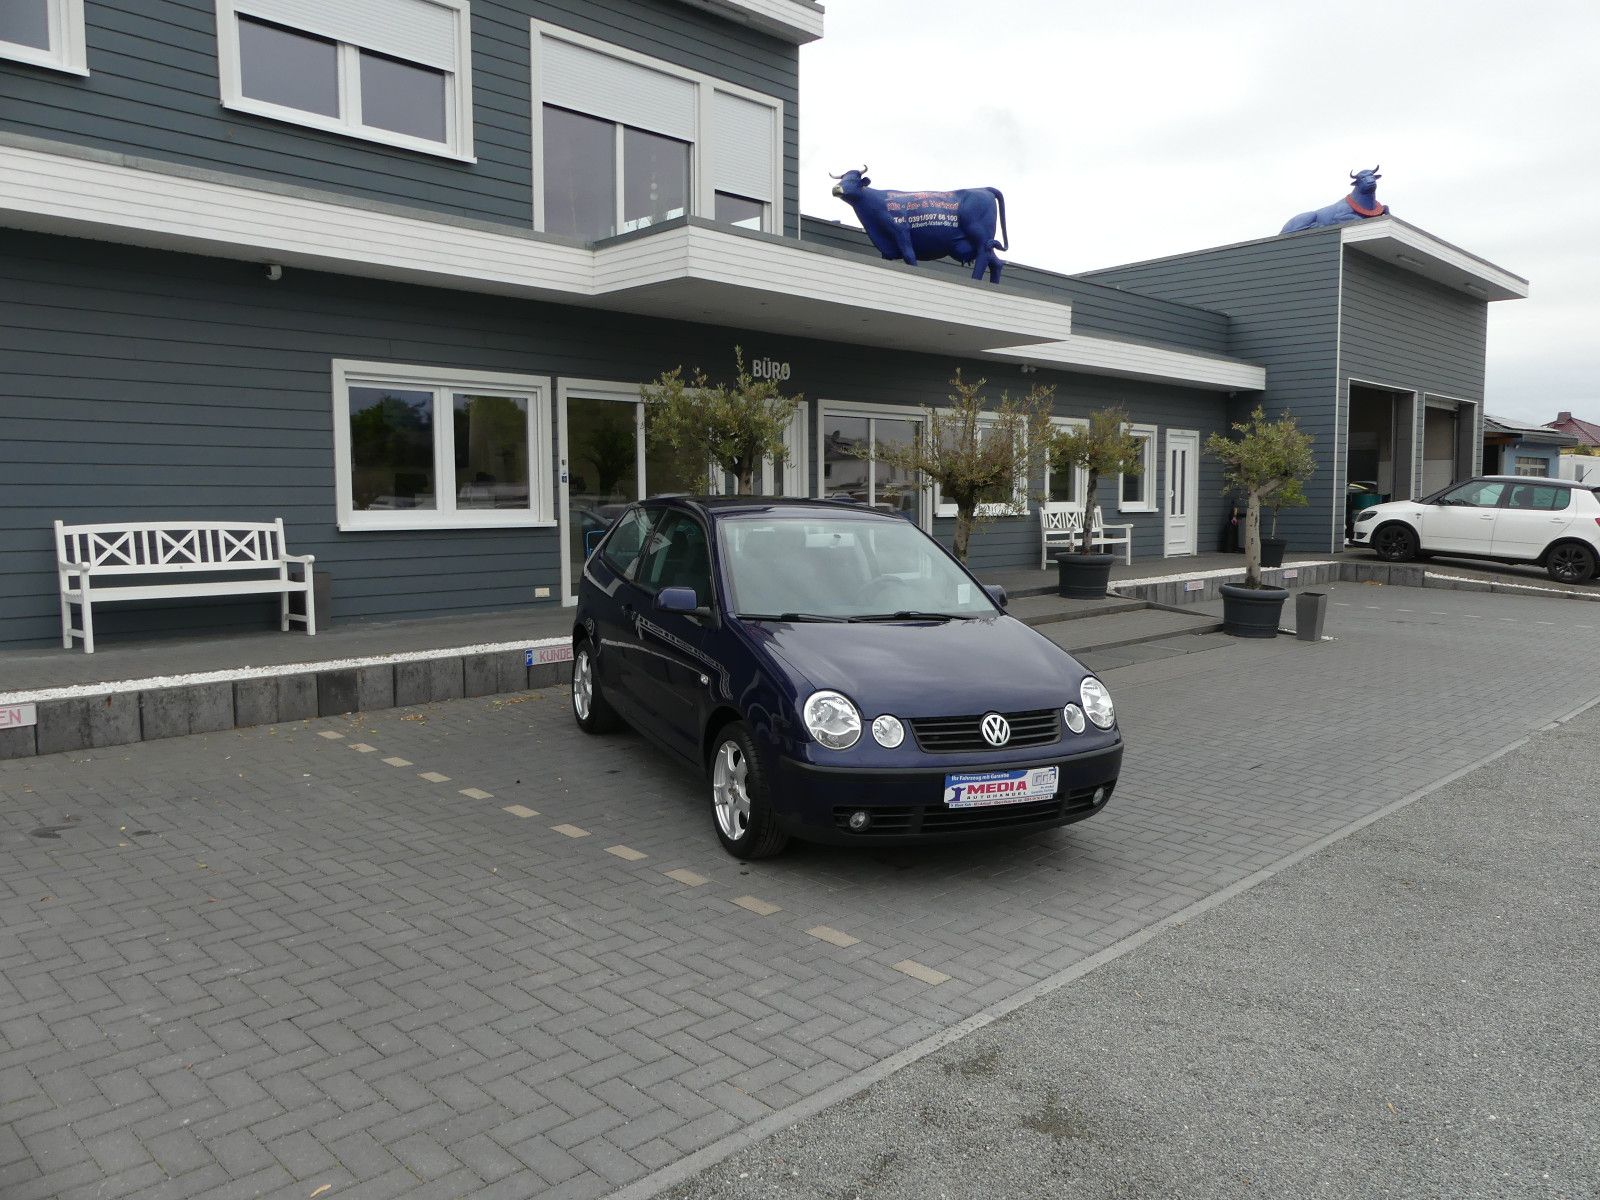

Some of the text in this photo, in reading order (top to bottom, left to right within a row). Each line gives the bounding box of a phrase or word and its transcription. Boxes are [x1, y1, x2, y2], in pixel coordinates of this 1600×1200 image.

[893, 216, 906, 224] Tel.
[752, 357, 791, 380] BÜRO
[982, 714, 1010, 746] VW
[967, 781, 1027, 795] MEDIA
[966, 791, 1028, 800] AUTOHANDEL
